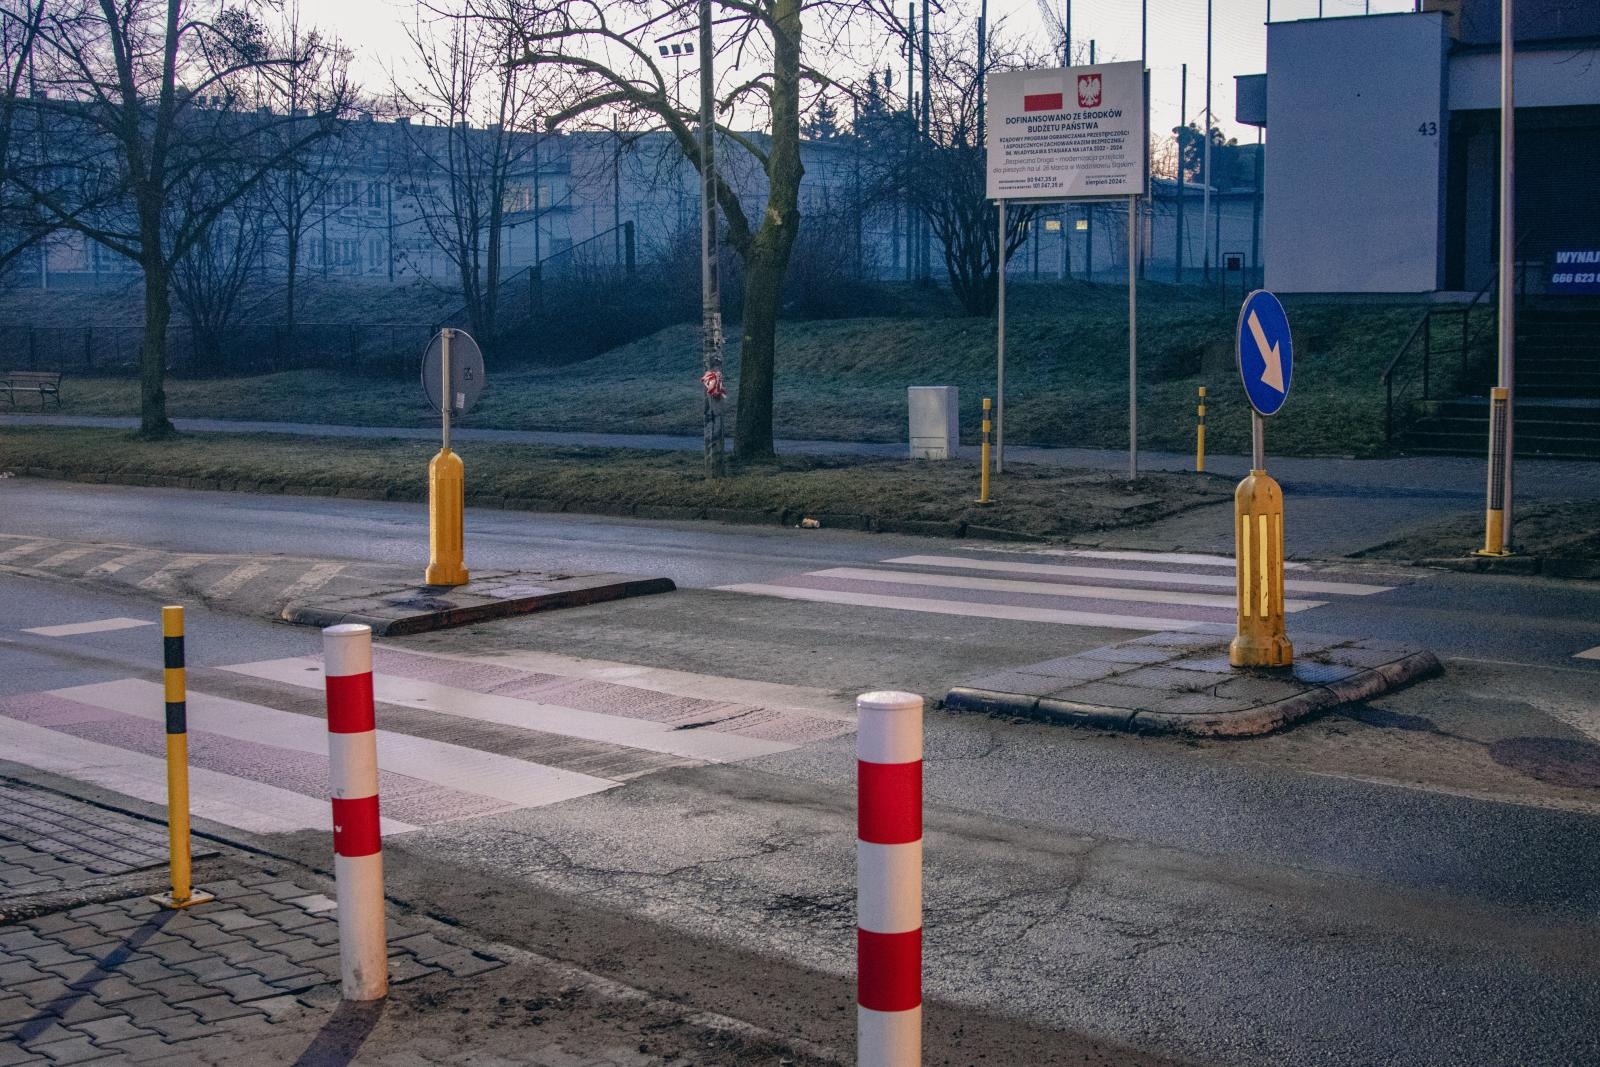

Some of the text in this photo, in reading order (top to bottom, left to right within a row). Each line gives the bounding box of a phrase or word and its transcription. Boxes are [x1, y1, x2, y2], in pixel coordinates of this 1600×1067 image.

[1005, 113, 1071, 125] DOFINANSOWANO
[1083, 109, 1122, 119] ŚRODKÓW
[1028, 121, 1098, 133] BUDŻETU PAŃSTWA
[1418, 122, 1437, 136] 43
[1049, 132, 1086, 140] OGRANICZANIA
[1087, 130, 1129, 138] PRZESTĘPCZOŚCI
[1574, 273, 1595, 283] 623
